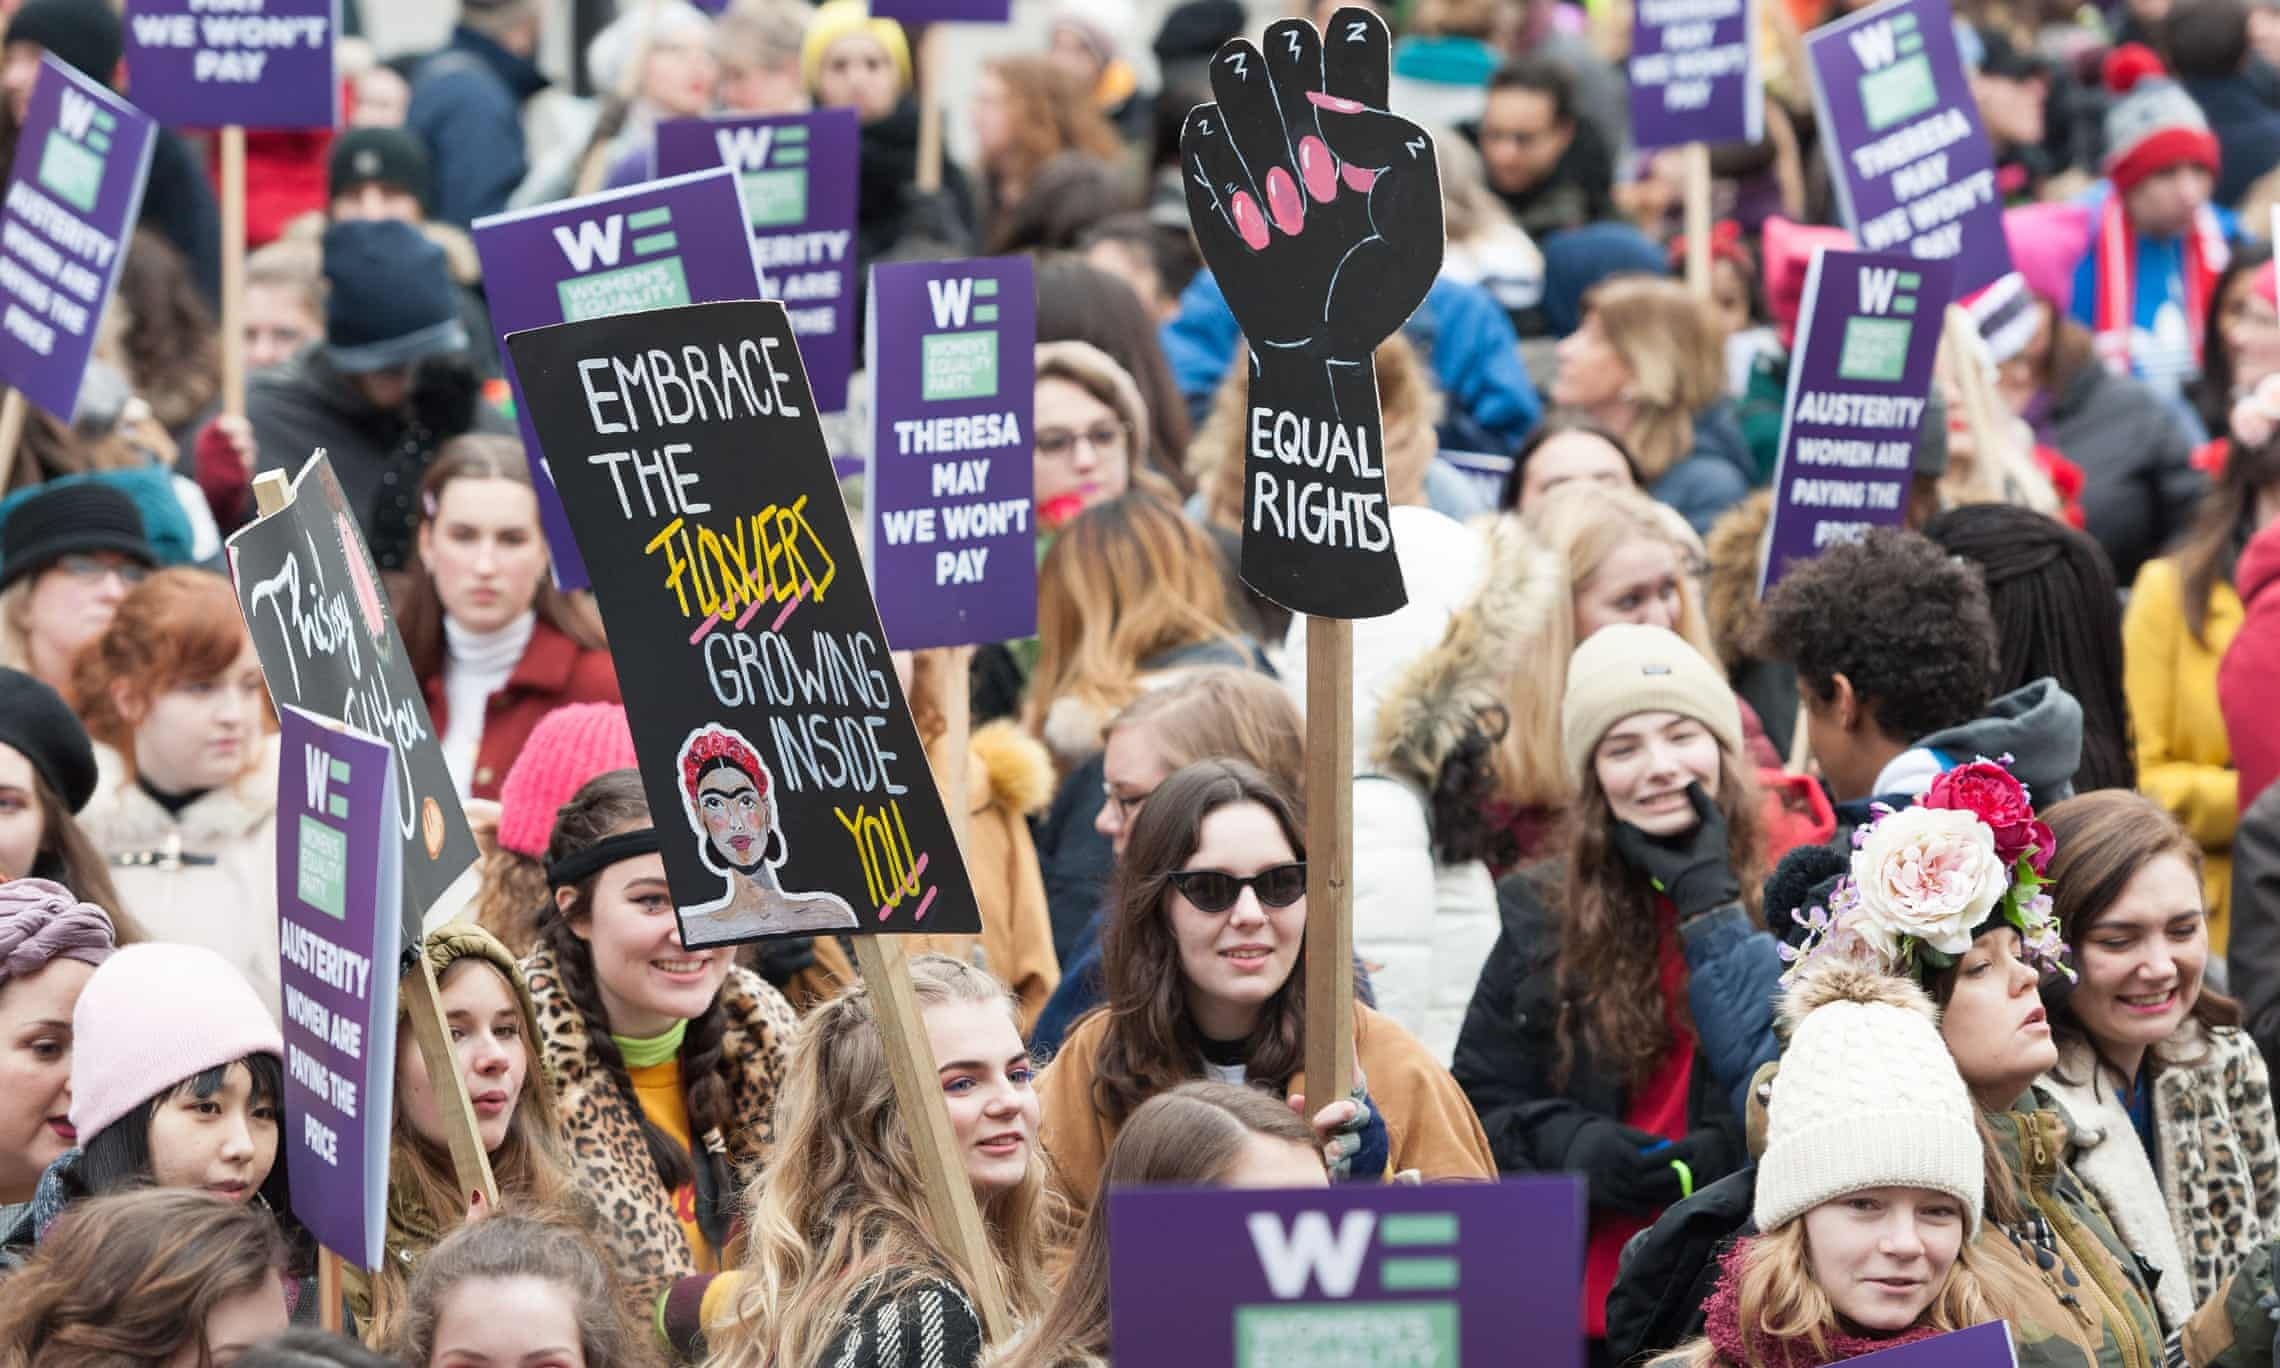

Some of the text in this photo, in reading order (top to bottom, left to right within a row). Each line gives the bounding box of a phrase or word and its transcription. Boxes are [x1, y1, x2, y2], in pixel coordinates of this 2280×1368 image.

[132, 14, 328, 48] WE WON'T
[195, 50, 267, 83] PAY
[1851, 107, 1972, 180] THERESA
[1892, 151, 1949, 202] MAY
[6, 180, 117, 268] AUSTERITY
[1860, 168, 1995, 251] WE WON'T
[756, 229, 850, 267] ERITY
[783, 270, 842, 300] ARE
[577, 337, 800, 434] EMBRACE
[1796, 391, 1925, 430] AUSTERITY
[894, 411, 1021, 455] THERESA
[1252, 407, 1384, 478] EQUAL
[1796, 437, 1912, 470] WOMEN ARE
[588, 443, 711, 520] THE
[933, 458, 990, 497] MAY
[1252, 471, 1391, 552] RIGHTS
[1789, 477, 1901, 510] PAYING THE
[644, 494, 836, 621] FLOWERS
[882, 498, 1030, 546] WE WON'T
[936, 546, 989, 586] PAY
[704, 630, 890, 710] GROWING
[769, 713, 909, 795] INSIDE
[833, 798, 920, 909] YOU
[281, 917, 369, 1000] AUSTERITY
[285, 983, 362, 1059] WOMEN ARE
[289, 1043, 357, 1119] PAYING THE
[304, 1112, 338, 1167] PRICE
